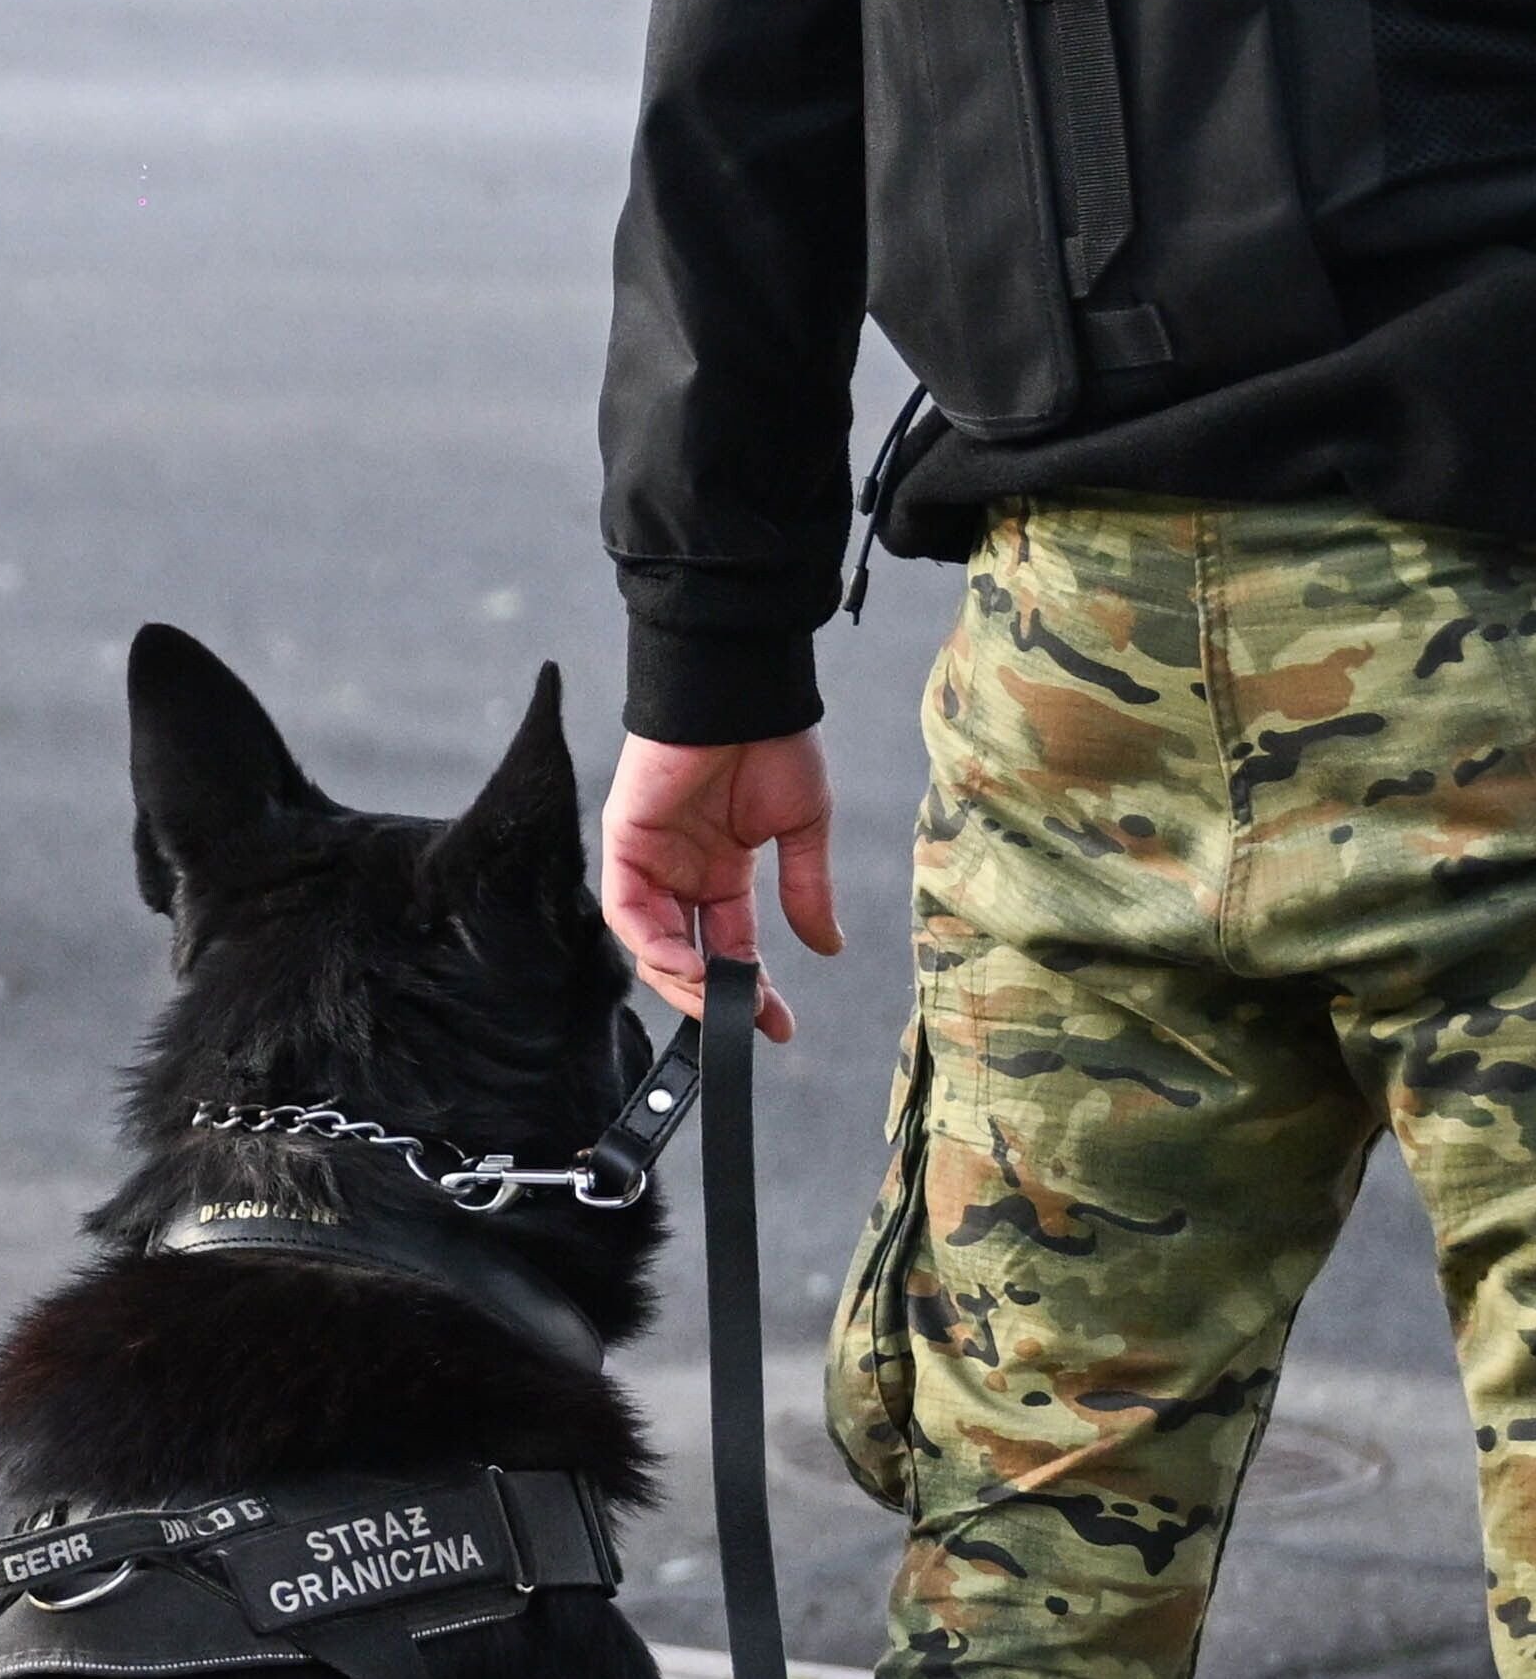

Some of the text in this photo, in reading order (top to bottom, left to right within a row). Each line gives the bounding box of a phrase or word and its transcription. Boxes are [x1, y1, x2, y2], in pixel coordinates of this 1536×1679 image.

[199, 1200, 268, 1224] DIGO
[2, 1533, 94, 1583] GEAR
[159, 1506, 236, 1544] DINO
[305, 1505, 431, 1562] STRAŻ
[269, 1533, 484, 1613] GRANICZNA
